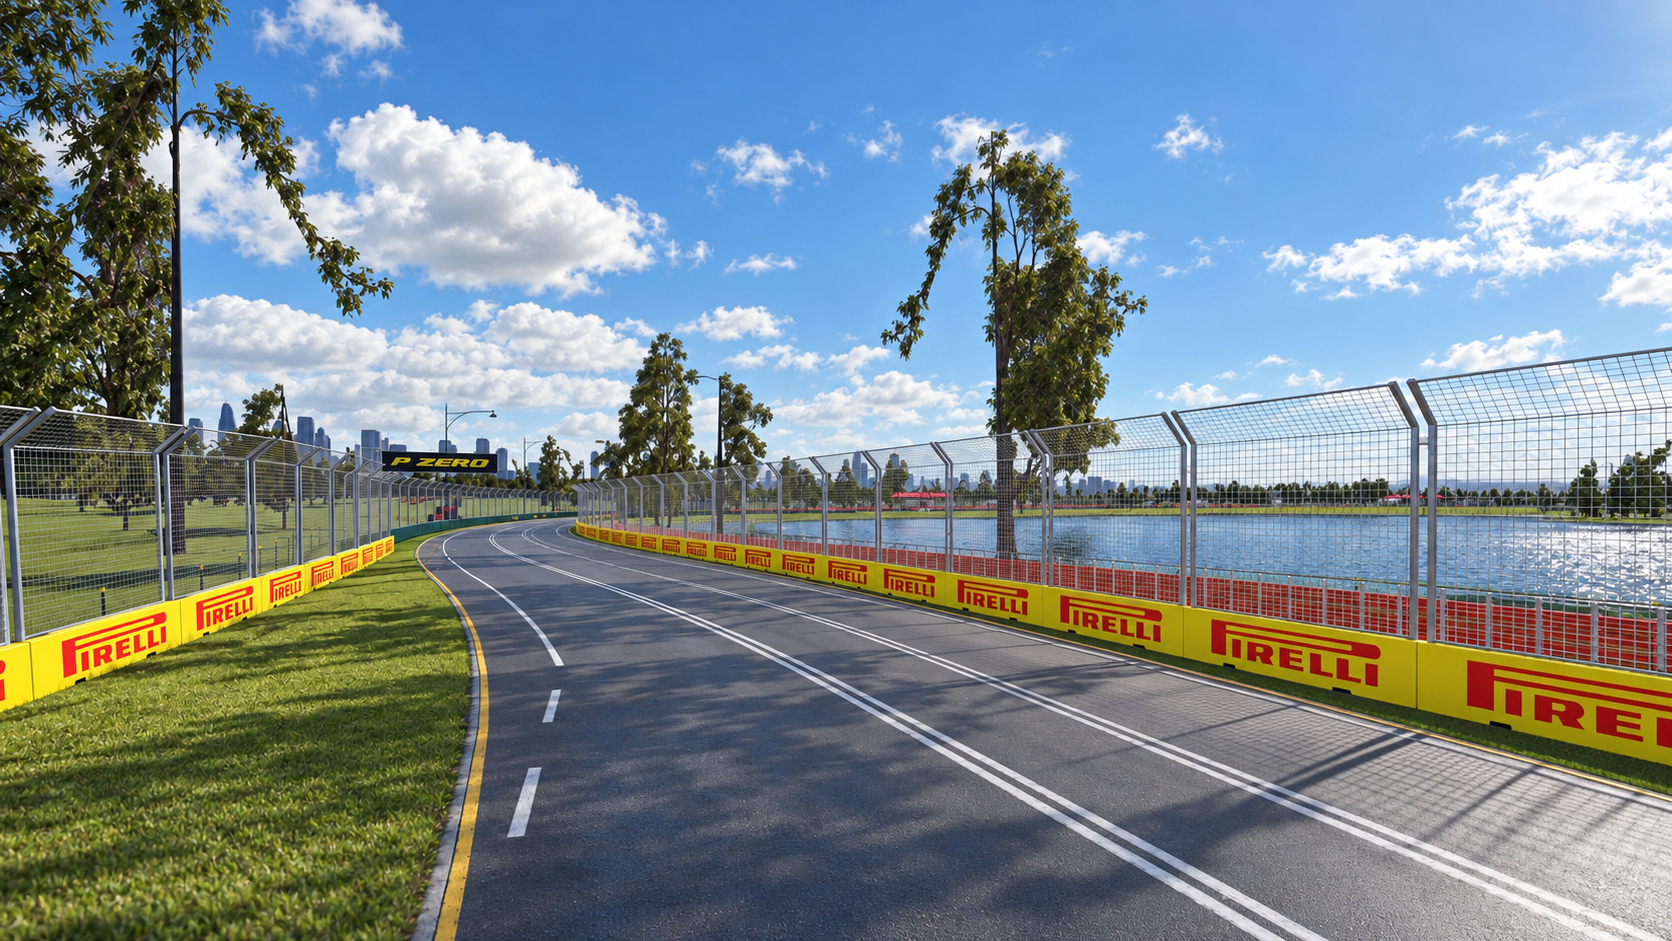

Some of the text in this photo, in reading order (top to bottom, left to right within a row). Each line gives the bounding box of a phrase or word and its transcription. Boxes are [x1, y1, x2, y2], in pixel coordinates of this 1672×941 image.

[391, 457, 489, 468] P ZERO
[782, 554, 816, 575] PIRELLI
[828, 560, 868, 585] PIRELLI
[270, 570, 302, 604] PIRELLI
[884, 568, 936, 597] PIRELLI
[957, 579, 1029, 616] PIRELLI
[196, 585, 254, 632] PIRELLI
[1060, 595, 1163, 643] PIRELLI
[62, 611, 167, 678] PIRELLI
[1211, 618, 1382, 688] PIRELLI
